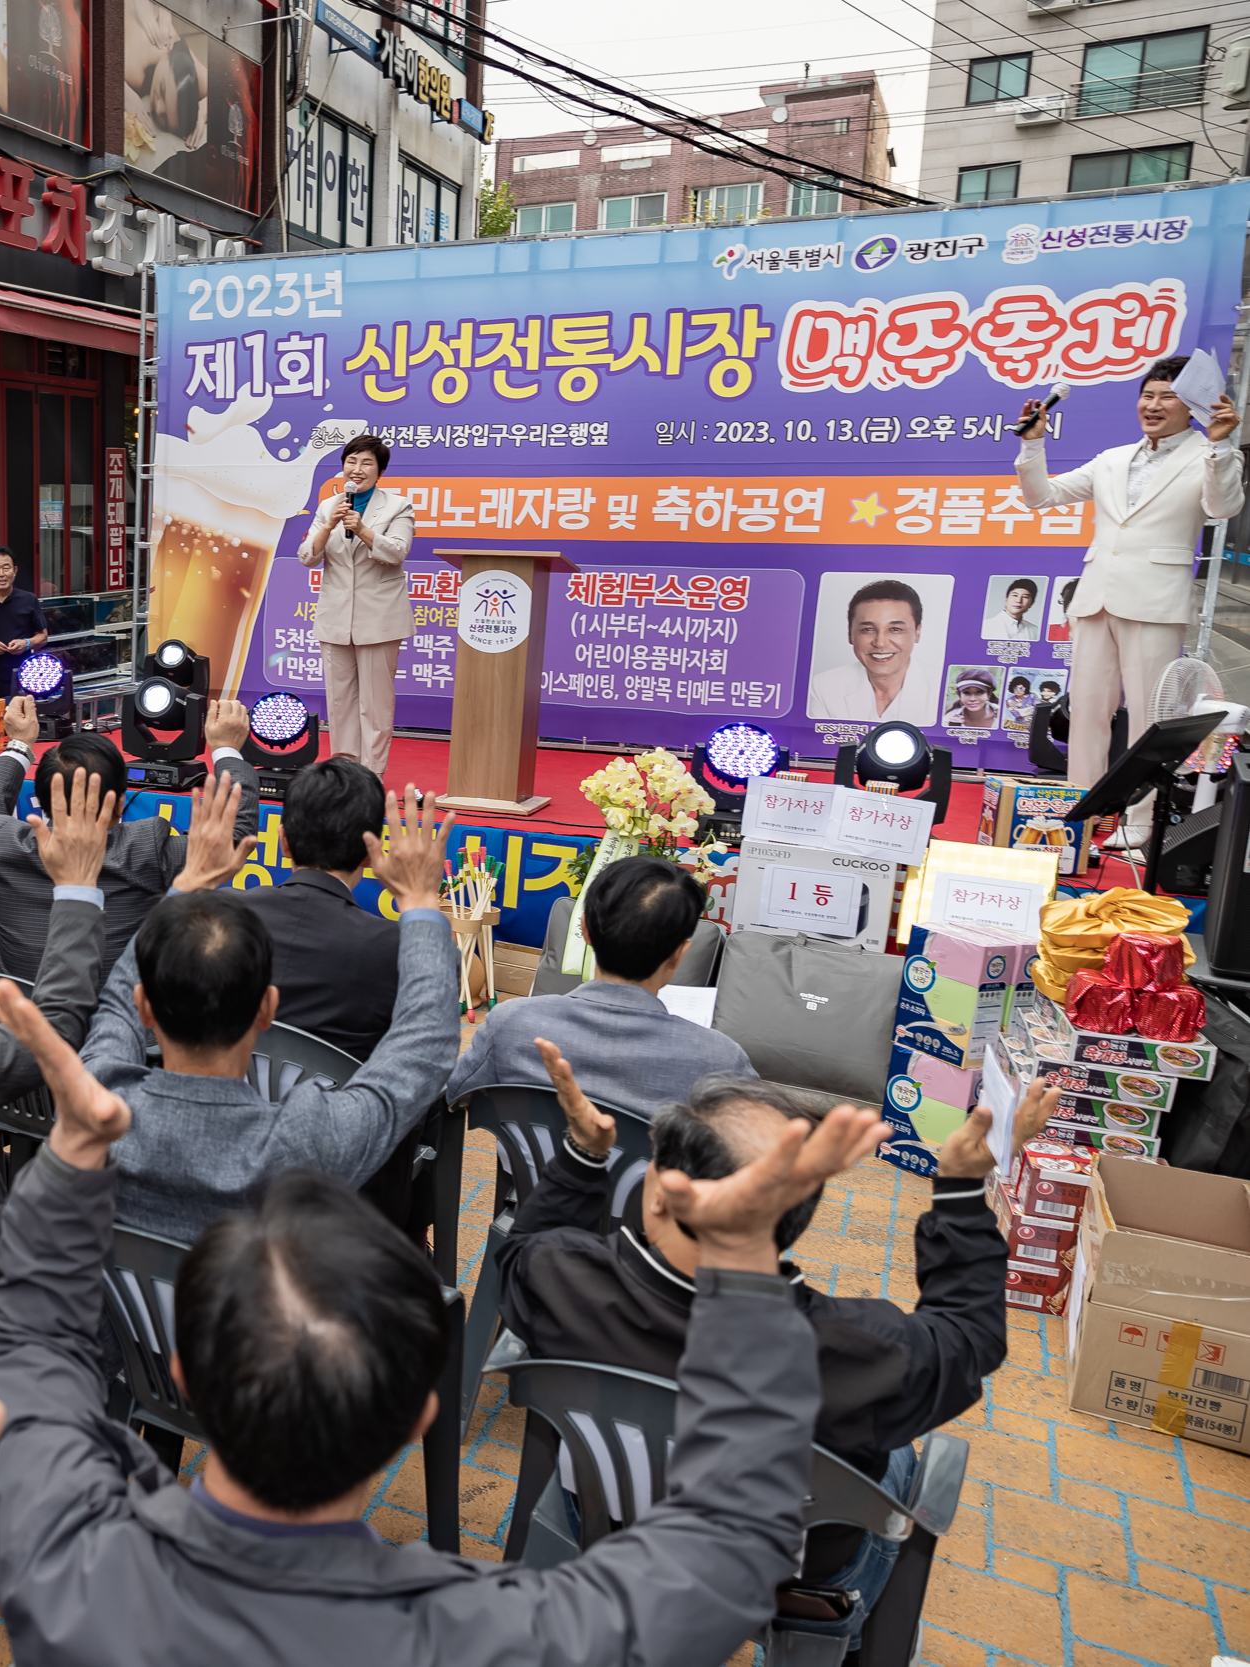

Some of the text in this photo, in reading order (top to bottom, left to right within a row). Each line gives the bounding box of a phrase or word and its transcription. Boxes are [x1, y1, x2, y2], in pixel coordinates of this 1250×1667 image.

[375, 27, 451, 124] 거북이한의원
[1039, 219, 1189, 251] 신성전통시장
[746, 244, 842, 272] 서울특별시
[904, 237, 986, 262] 광진구
[187, 269, 344, 321] 2023년
[185, 286, 1182, 404] 제1회 신성전통시장 맥주축제
[310, 426, 346, 449] 장소
[654, 420, 695, 445] 일시
[713, 420, 777, 444] 2023.
[784, 418, 818, 443] 10.
[826, 416, 903, 444] 13.(금)
[904, 417, 957, 442] 오후
[380, 486, 597, 530] 민노래자랑
[607, 494, 638, 531] 및
[651, 485, 826, 534] 축하공연
[405, 569, 464, 603] 교환
[566, 571, 751, 613] 체험부스운영
[469, 623, 518, 635] 신성전통시장
[469, 634, 493, 645] SINCE
[570, 612, 739, 645] (1시부터~4시까지)
[412, 634, 455, 660] 맥주
[575, 643, 729, 675] 어린이용품바자회
[275, 656, 323, 682] 1만원
[412, 663, 454, 689] 맥주
[624, 676, 673, 704] 양말목
[676, 680, 726, 706] 티메트
[729, 682, 782, 710] 만들기
[763, 793, 826, 816] 참가자상
[848, 805, 914, 832] 참가자상
[832, 857, 891, 872] CUCKOO
[952, 887, 1024, 911] 참가자상
[1082, 1045, 1128, 1065] 육개장
[1109, 1039, 1129, 1051] 농심
[1045, 1071, 1089, 1092] 육개장
[1070, 1066, 1090, 1079] 농심
[894, 1084, 917, 1098] 깨끗한
